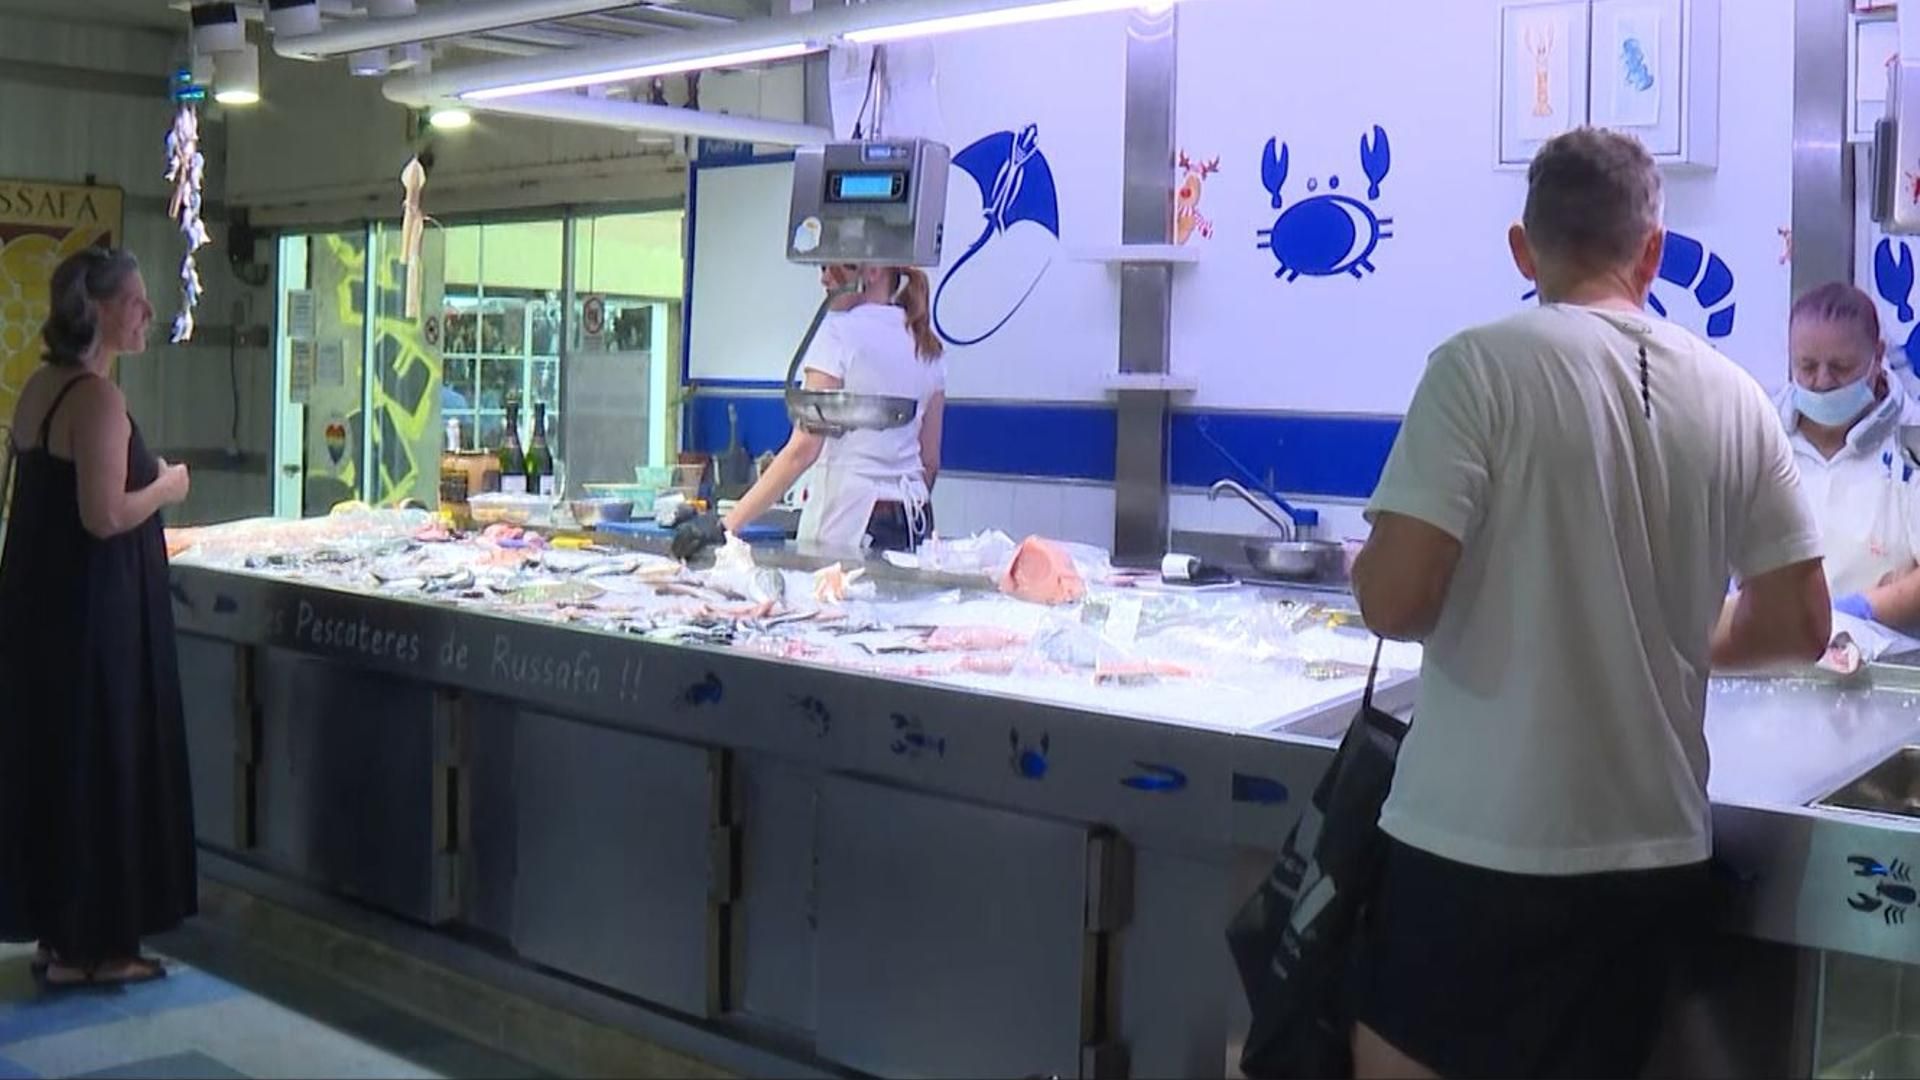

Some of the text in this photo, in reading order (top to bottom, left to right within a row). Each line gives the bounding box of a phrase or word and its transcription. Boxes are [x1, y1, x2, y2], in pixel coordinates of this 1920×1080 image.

[295, 599, 419, 662] Pescateres
[439, 625, 468, 671] de
[491, 634, 601, 692] Russafa
[618, 656, 644, 702] !!
